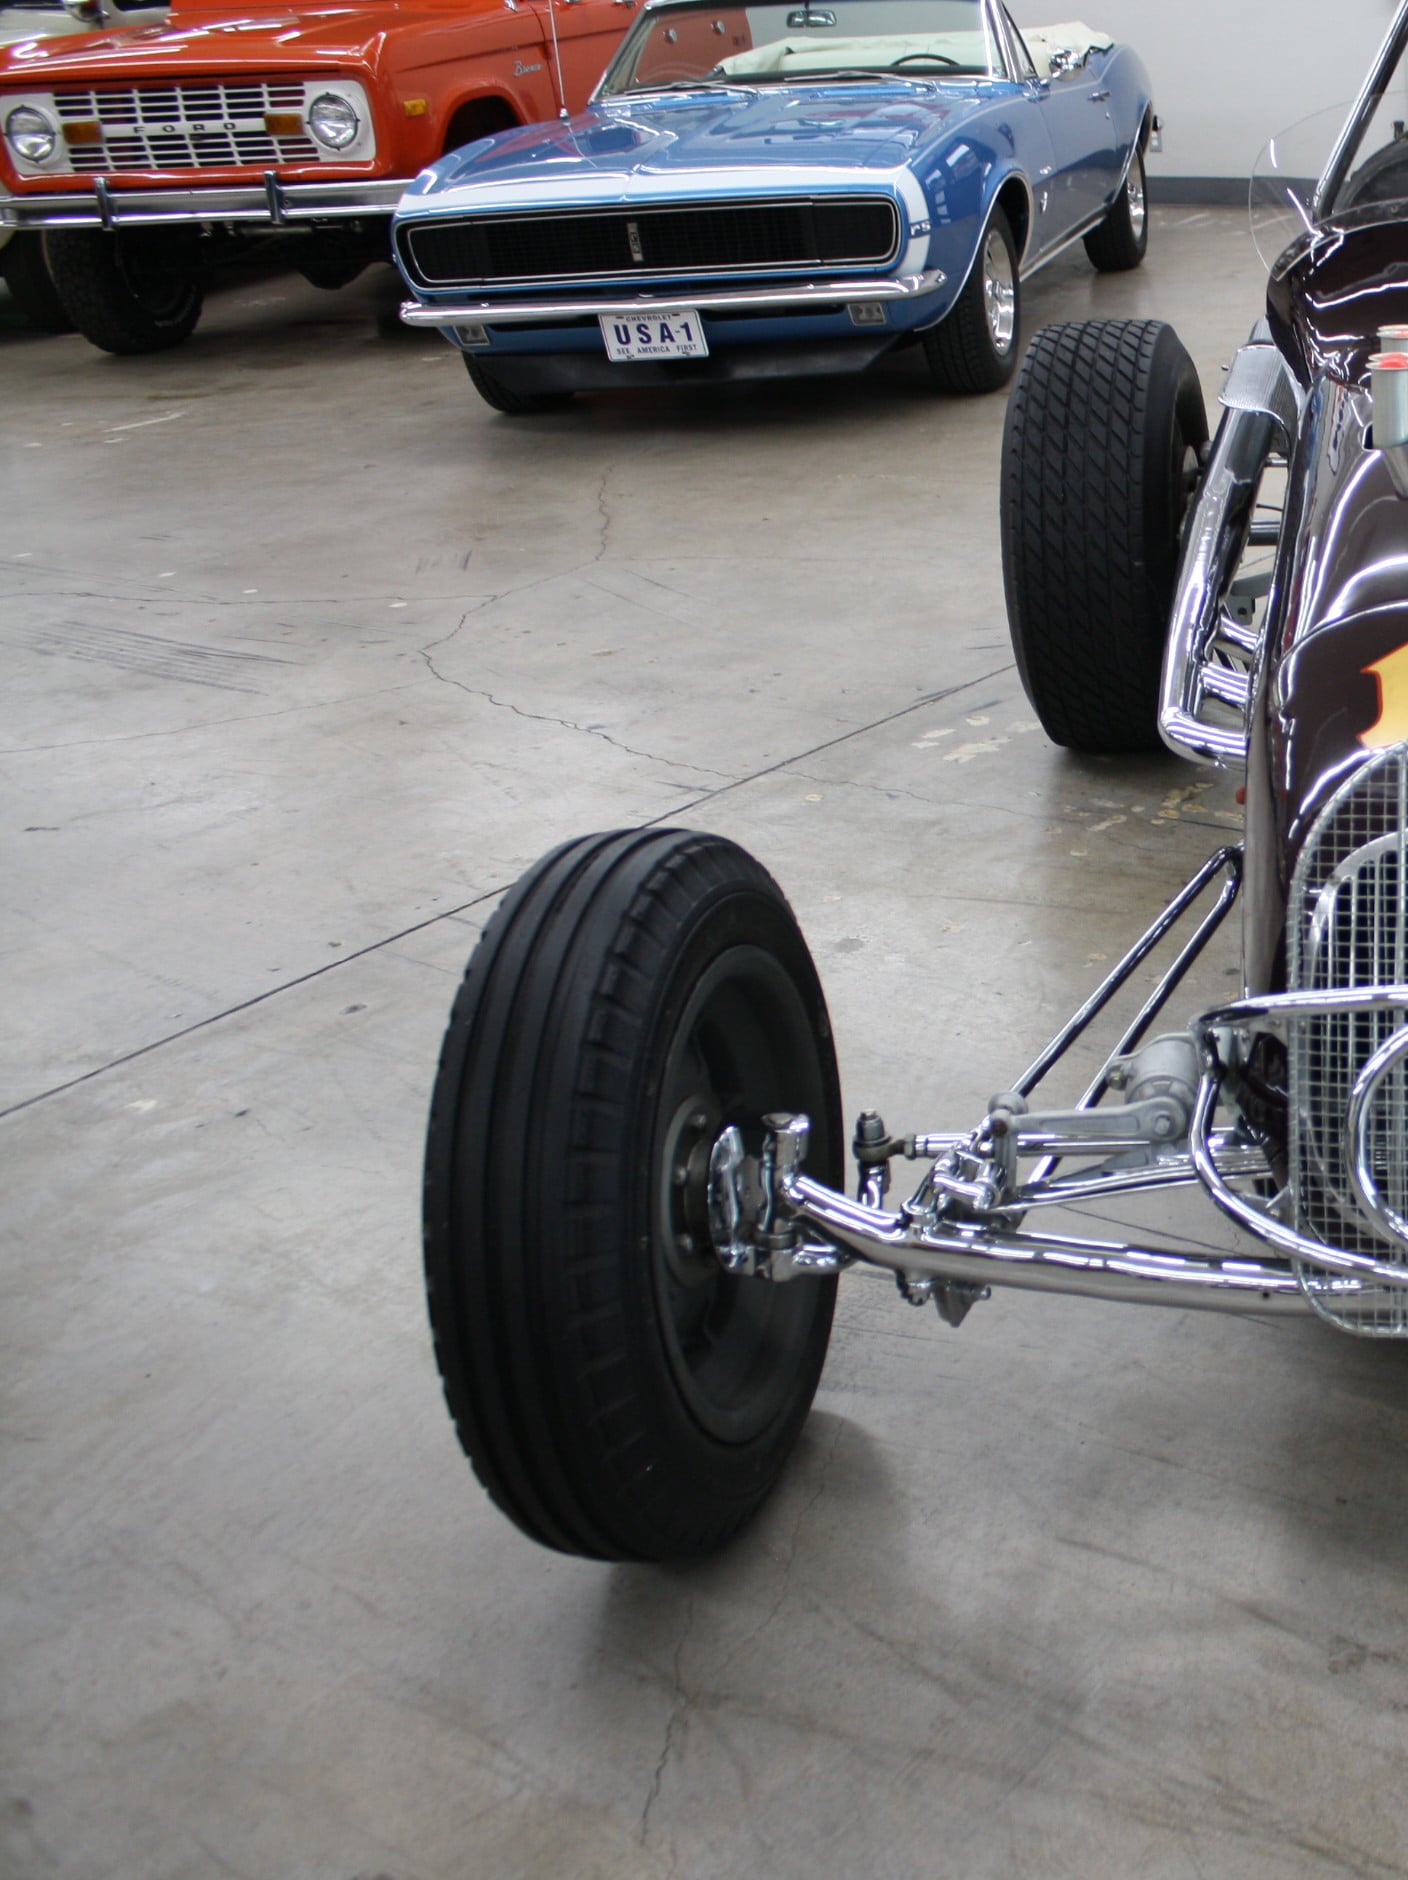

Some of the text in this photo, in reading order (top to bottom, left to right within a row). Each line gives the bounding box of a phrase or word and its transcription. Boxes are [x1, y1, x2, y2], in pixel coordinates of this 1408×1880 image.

[133, 122, 236, 133] FORD
[626, 314, 672, 322] CHEVROLET
[638, 345, 670, 354] AMERICA
[676, 344, 697, 352] FIRST
